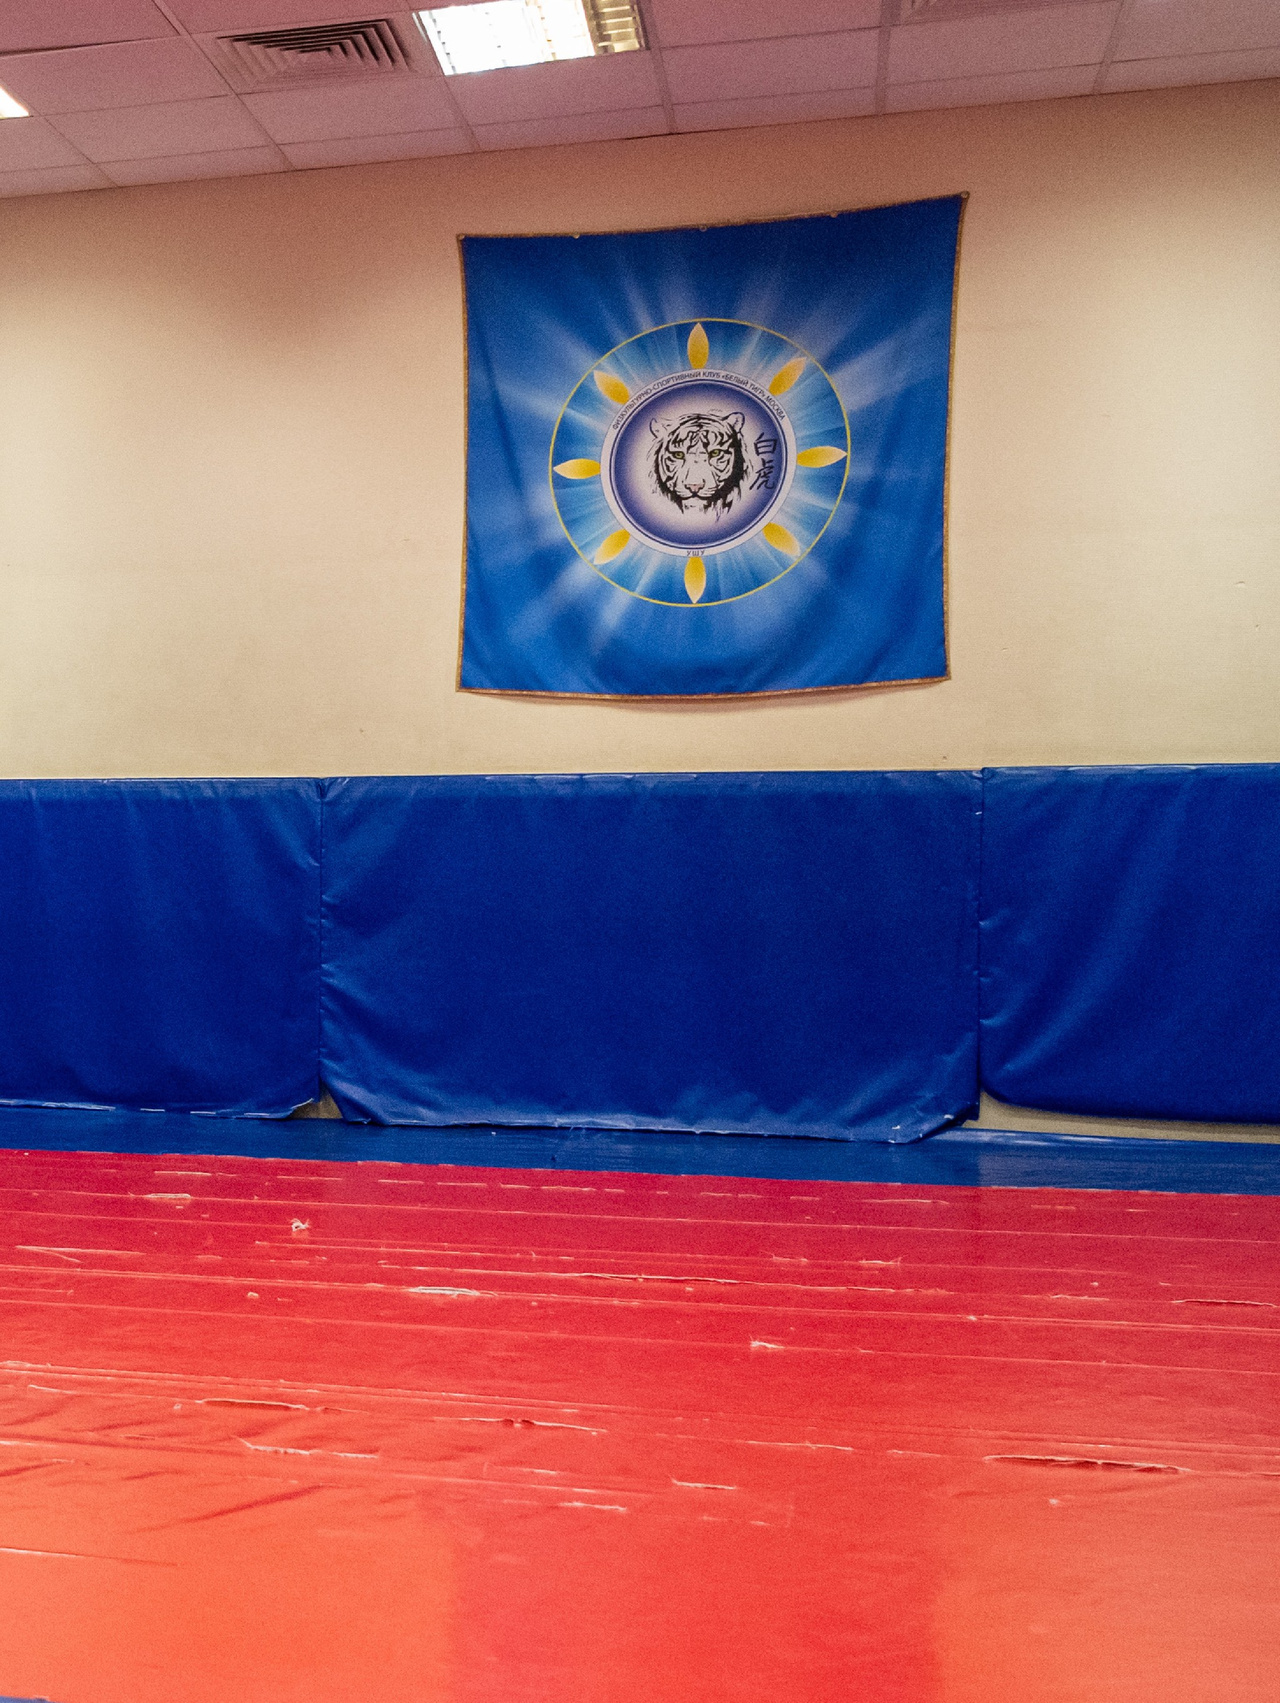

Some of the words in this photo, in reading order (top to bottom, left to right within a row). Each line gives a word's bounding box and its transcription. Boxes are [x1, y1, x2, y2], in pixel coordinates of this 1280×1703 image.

[612, 371, 701, 430] ФИЗКУЛЬТУРНО-СПОРТИВНЫЙ
[702, 371, 720, 379] КЛУБ
[765, 395, 786, 421] МОСКВА
[749, 432, 777, 490] 白虎
